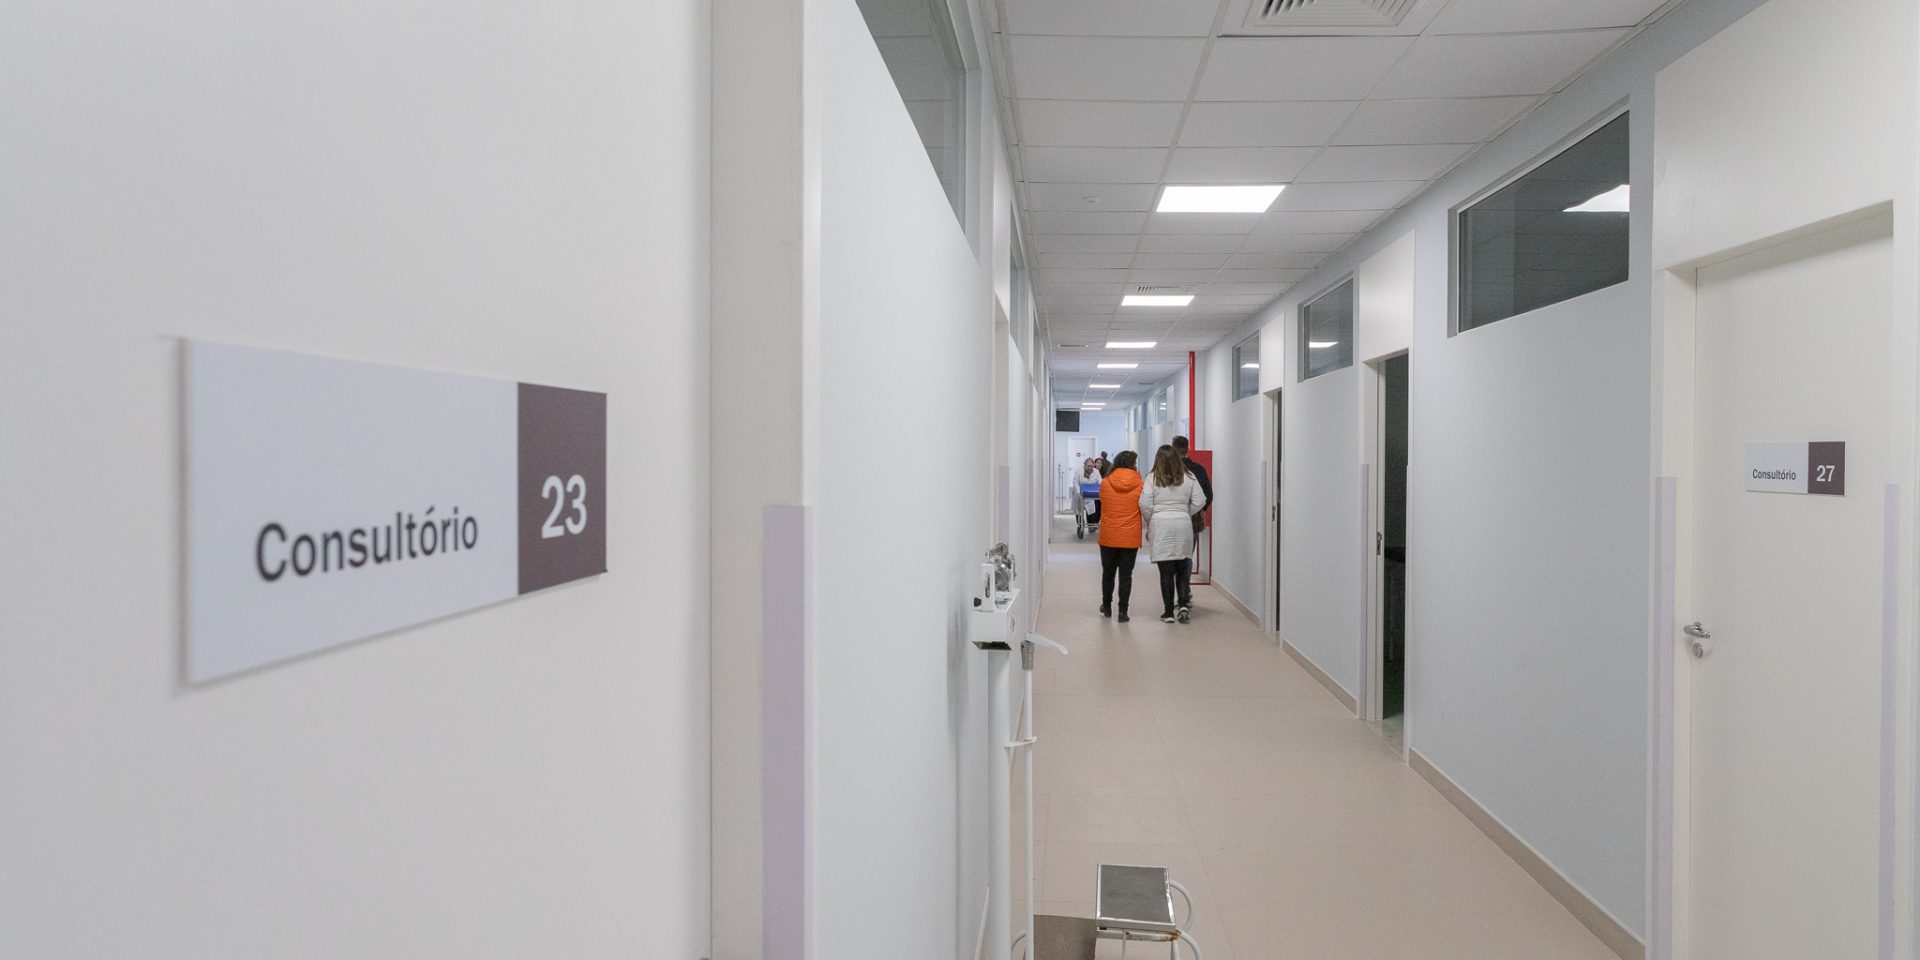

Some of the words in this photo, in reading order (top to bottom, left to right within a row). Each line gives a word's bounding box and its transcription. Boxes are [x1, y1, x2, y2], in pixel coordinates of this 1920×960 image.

[1752, 469, 1796, 480] Consultório
[1816, 465, 1835, 482] 27
[255, 506, 478, 583] Consultório
[541, 474, 588, 539] 23
